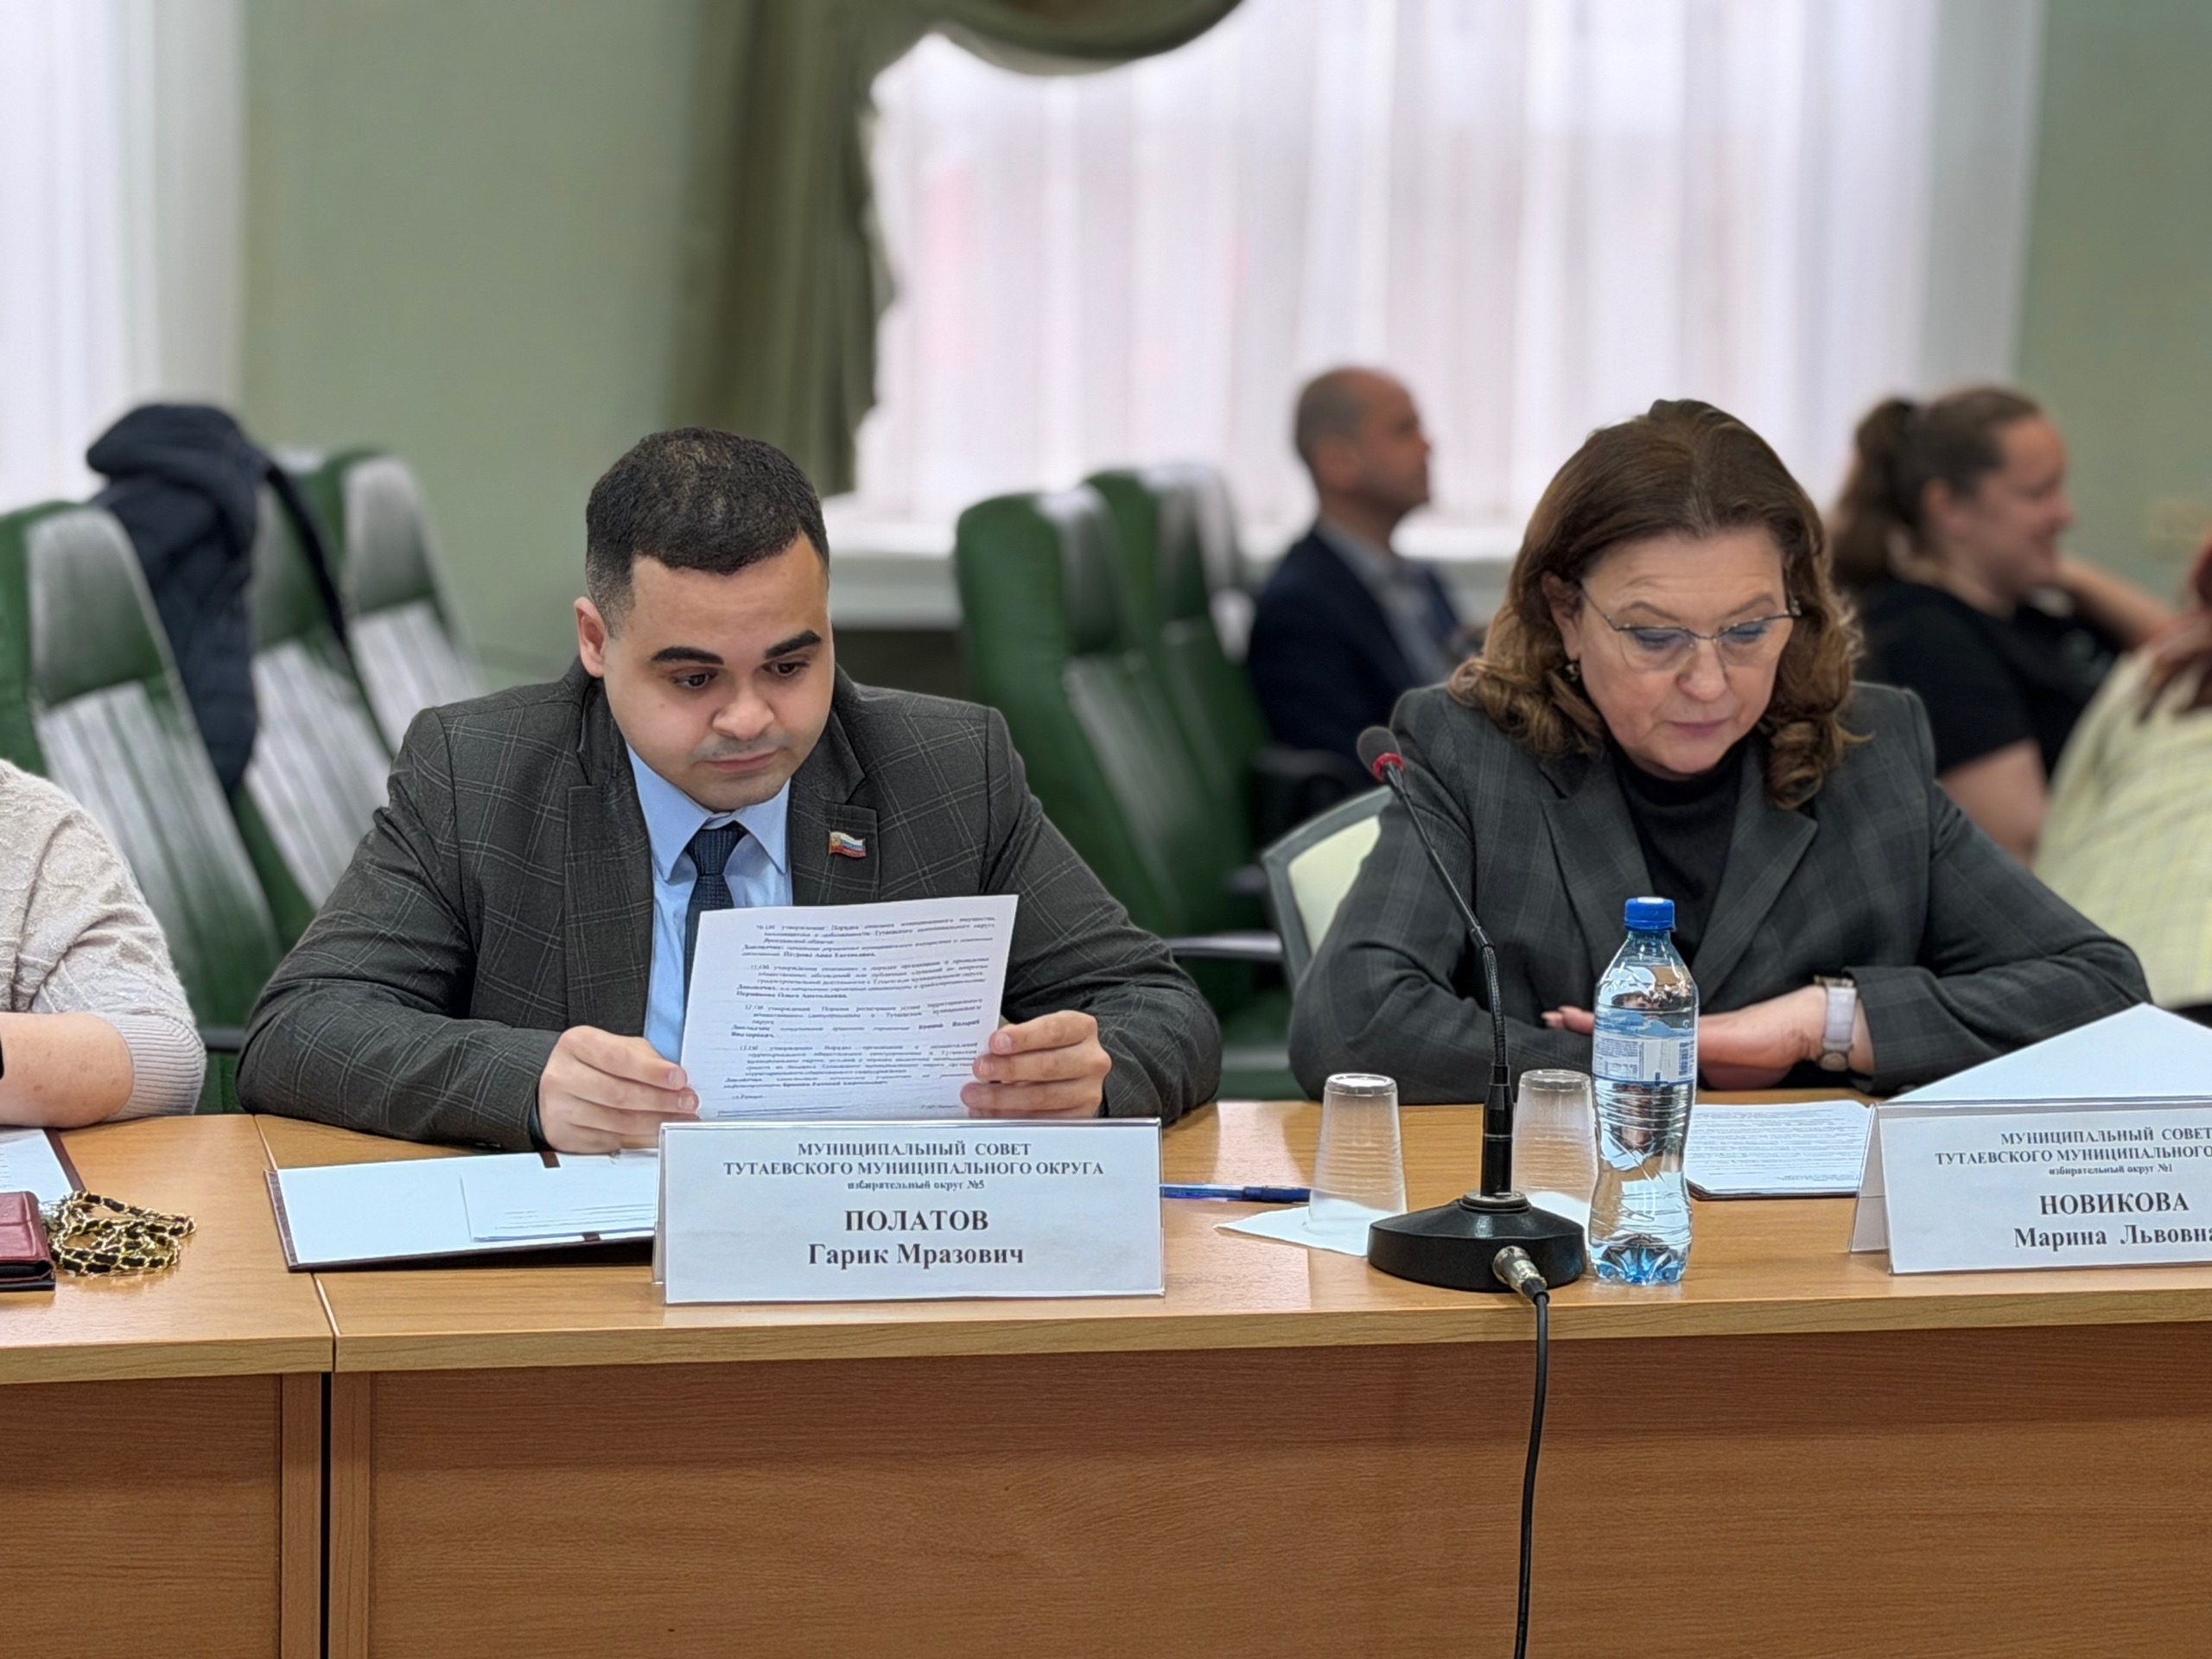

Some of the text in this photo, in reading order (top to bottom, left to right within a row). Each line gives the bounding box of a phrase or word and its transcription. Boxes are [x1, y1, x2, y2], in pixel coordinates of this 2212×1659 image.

[2000, 1126, 2212, 1146] МУНИЦИПАЛЬНЫЙ СОВЕТ
[798, 1140, 1031, 1157] МУНИЦИПАЛЬНЫЙ СОВЕТ
[1935, 1145, 2212, 1166] ТУТАЕВСКОГО МУНИЦИПАЛЬНОГО
[723, 1161, 1104, 1177] ТУТАЕВСКОГО МУНИЦИПАЛЬНОГО ОКРУГА
[2049, 1163, 2173, 1177] избирательный округ №1
[933, 1182, 963, 1192] округ
[967, 1179, 985, 1190] №5
[2039, 1192, 2190, 1216] НОВИКОВА
[844, 1210, 988, 1231] ПОЛАТОВ
[2013, 1227, 2107, 1252] Марина
[808, 1243, 1025, 1271] Гарик Мразович
